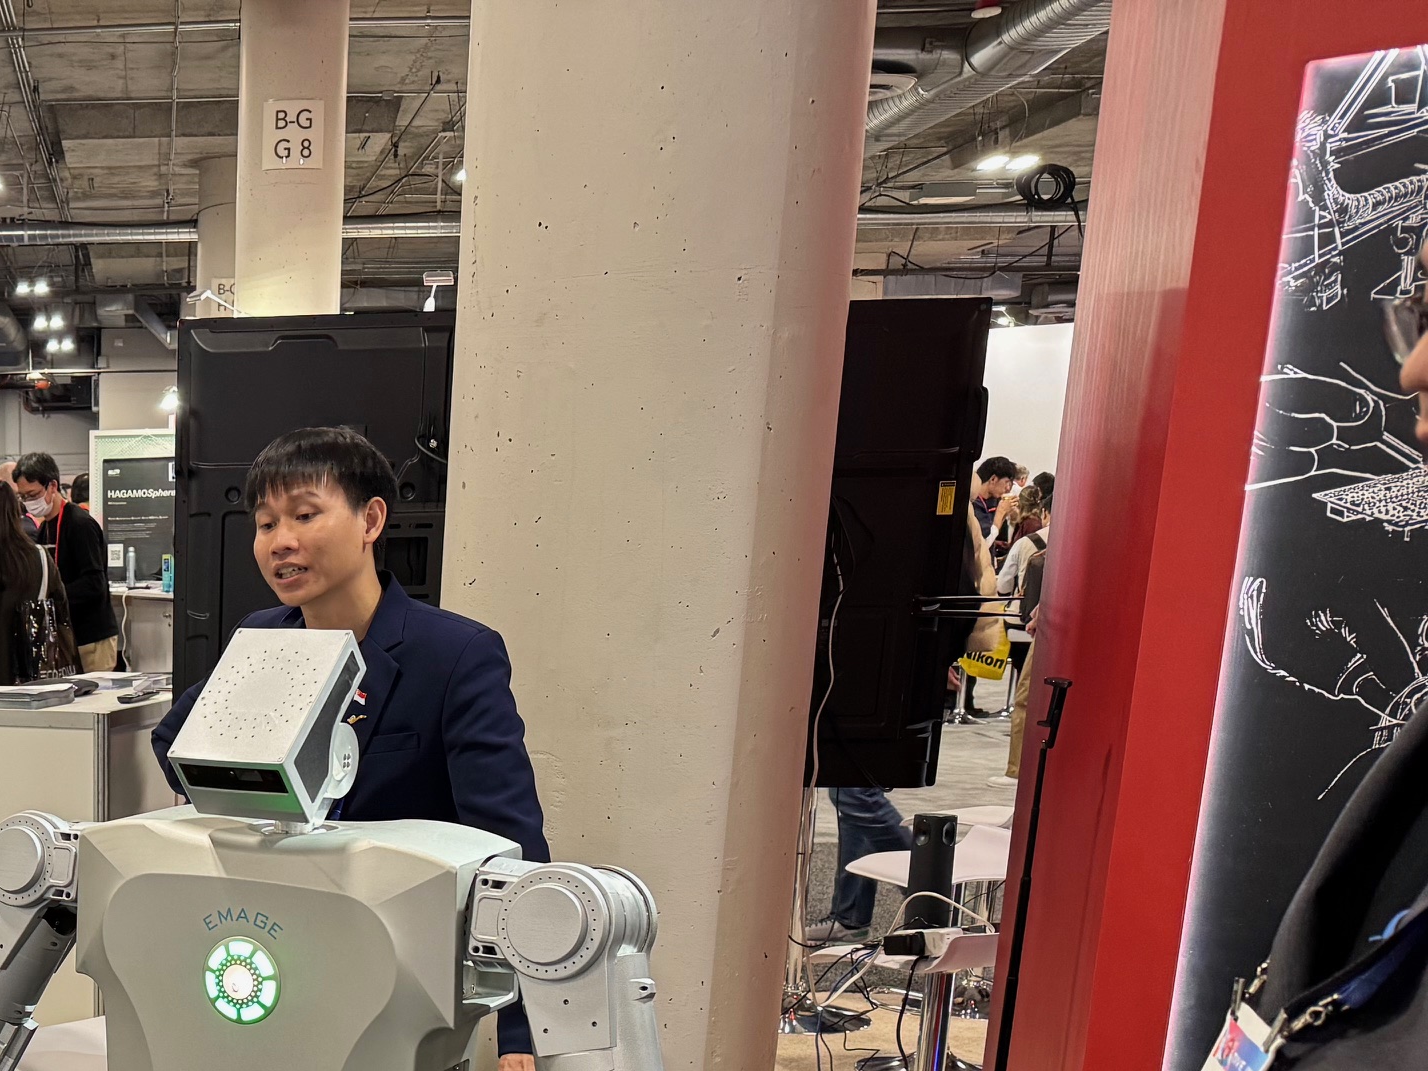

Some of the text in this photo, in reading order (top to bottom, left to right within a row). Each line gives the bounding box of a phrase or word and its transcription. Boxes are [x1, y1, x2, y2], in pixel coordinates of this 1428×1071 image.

[274, 108, 313, 130] B-G
[274, 138, 312, 159] G 8
[203, 907, 284, 940] EMAGE
